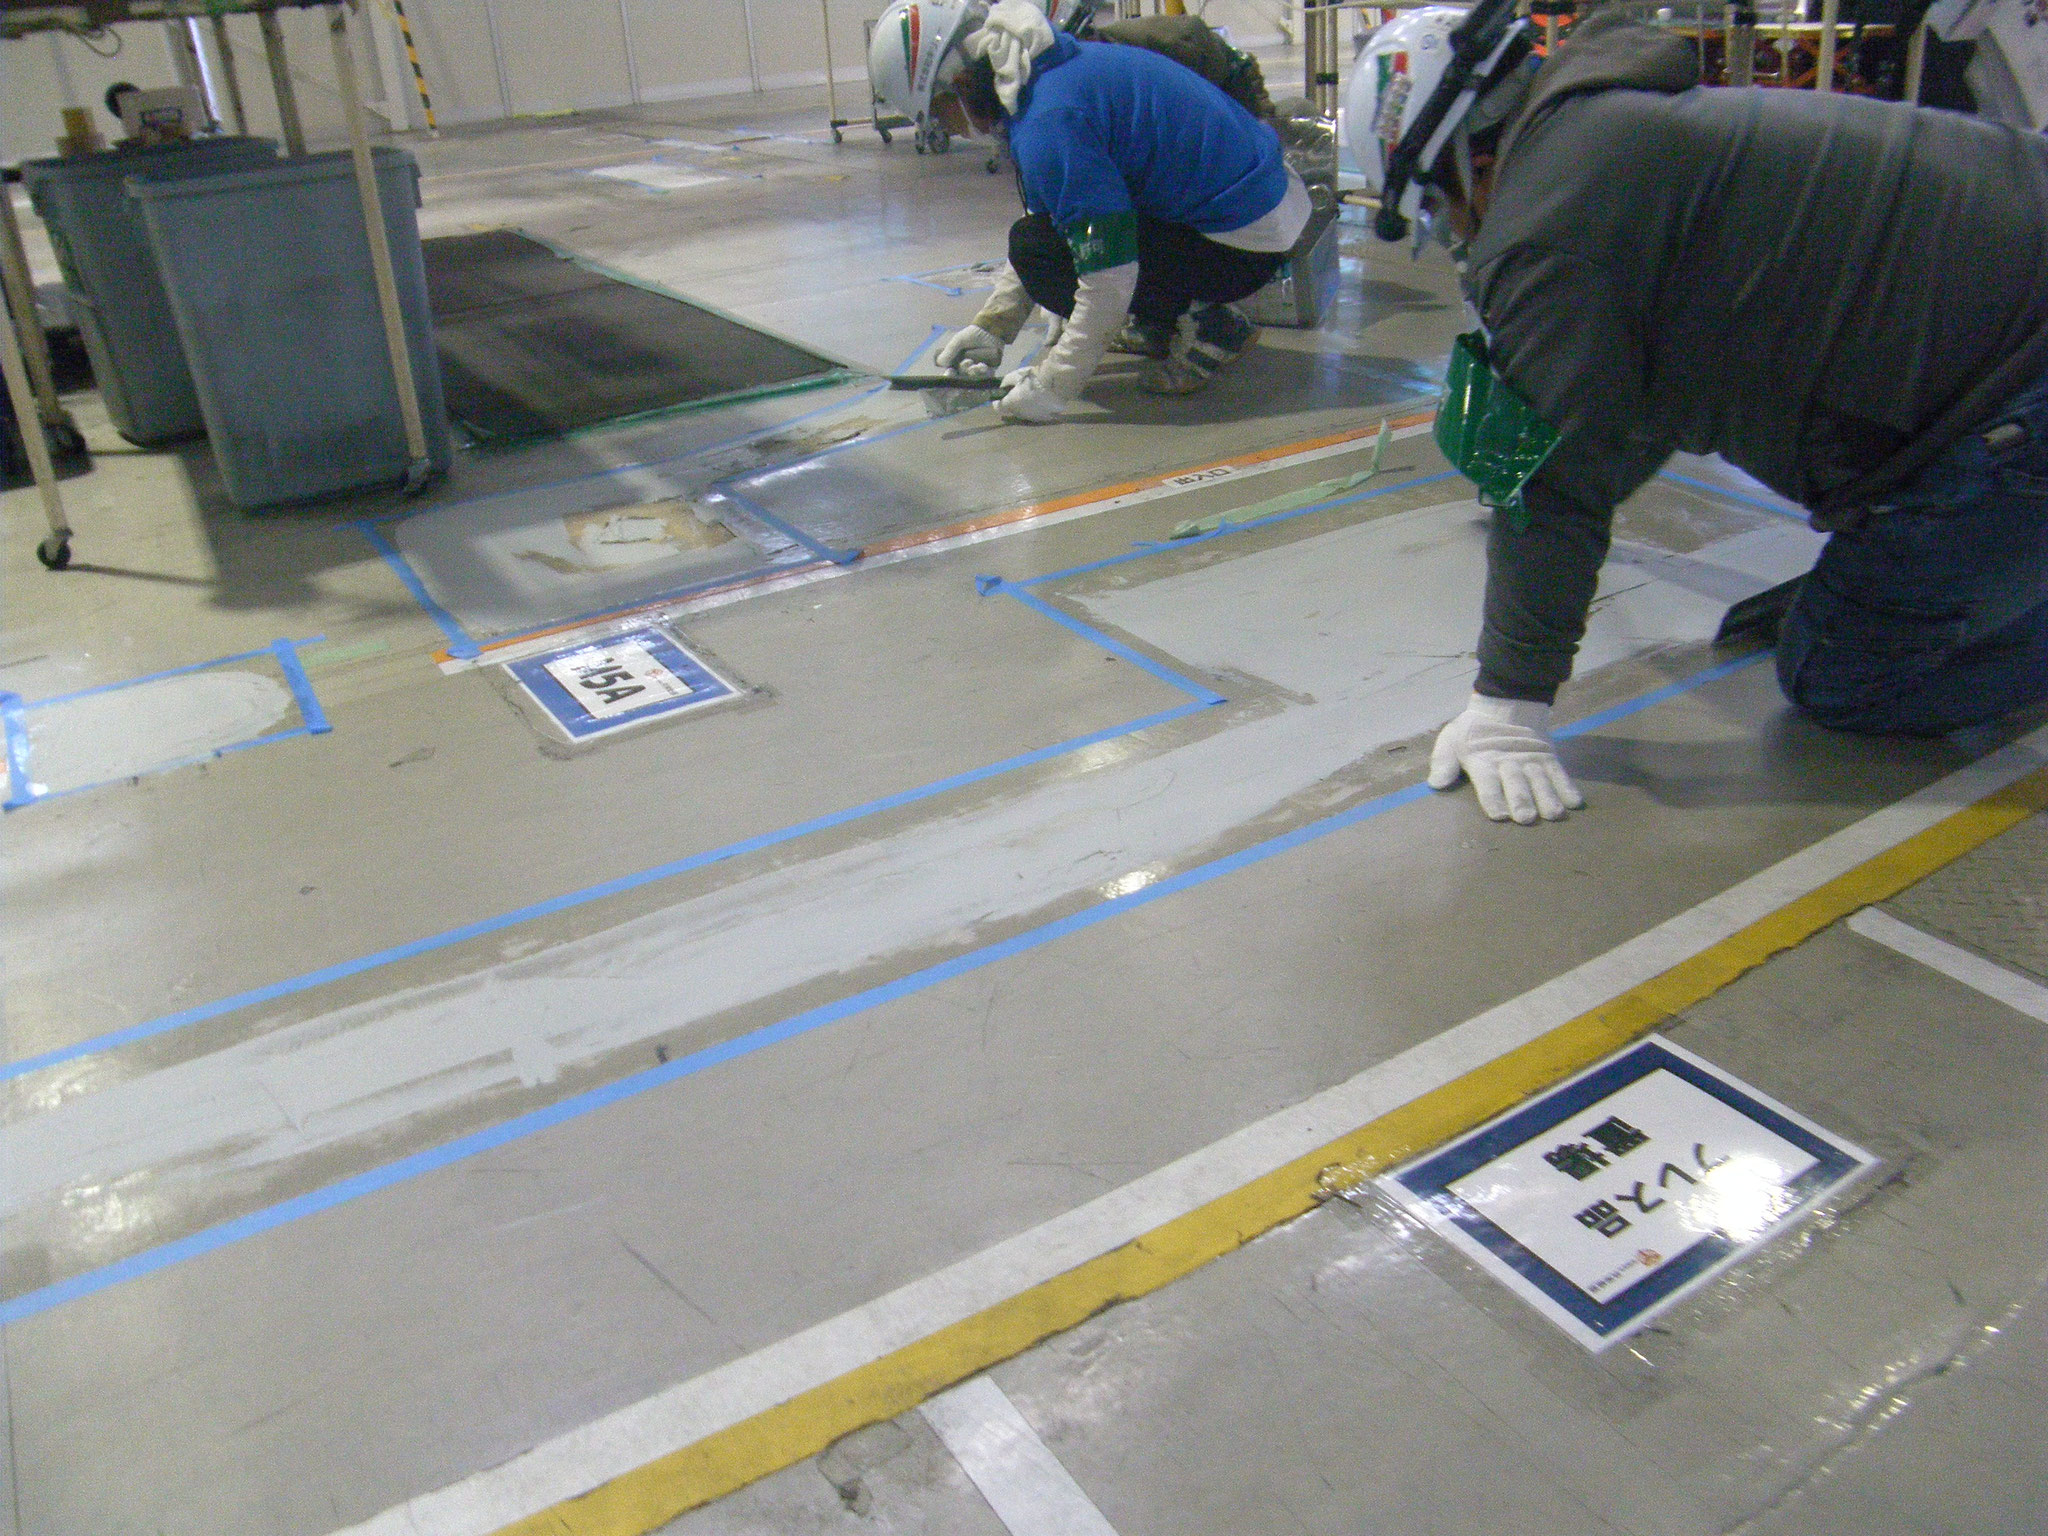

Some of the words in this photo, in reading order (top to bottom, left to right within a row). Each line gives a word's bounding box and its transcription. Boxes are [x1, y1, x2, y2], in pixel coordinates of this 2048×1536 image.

[1174, 469, 1230, 484] 出入口
[1543, 1116, 1651, 1181] 置場
